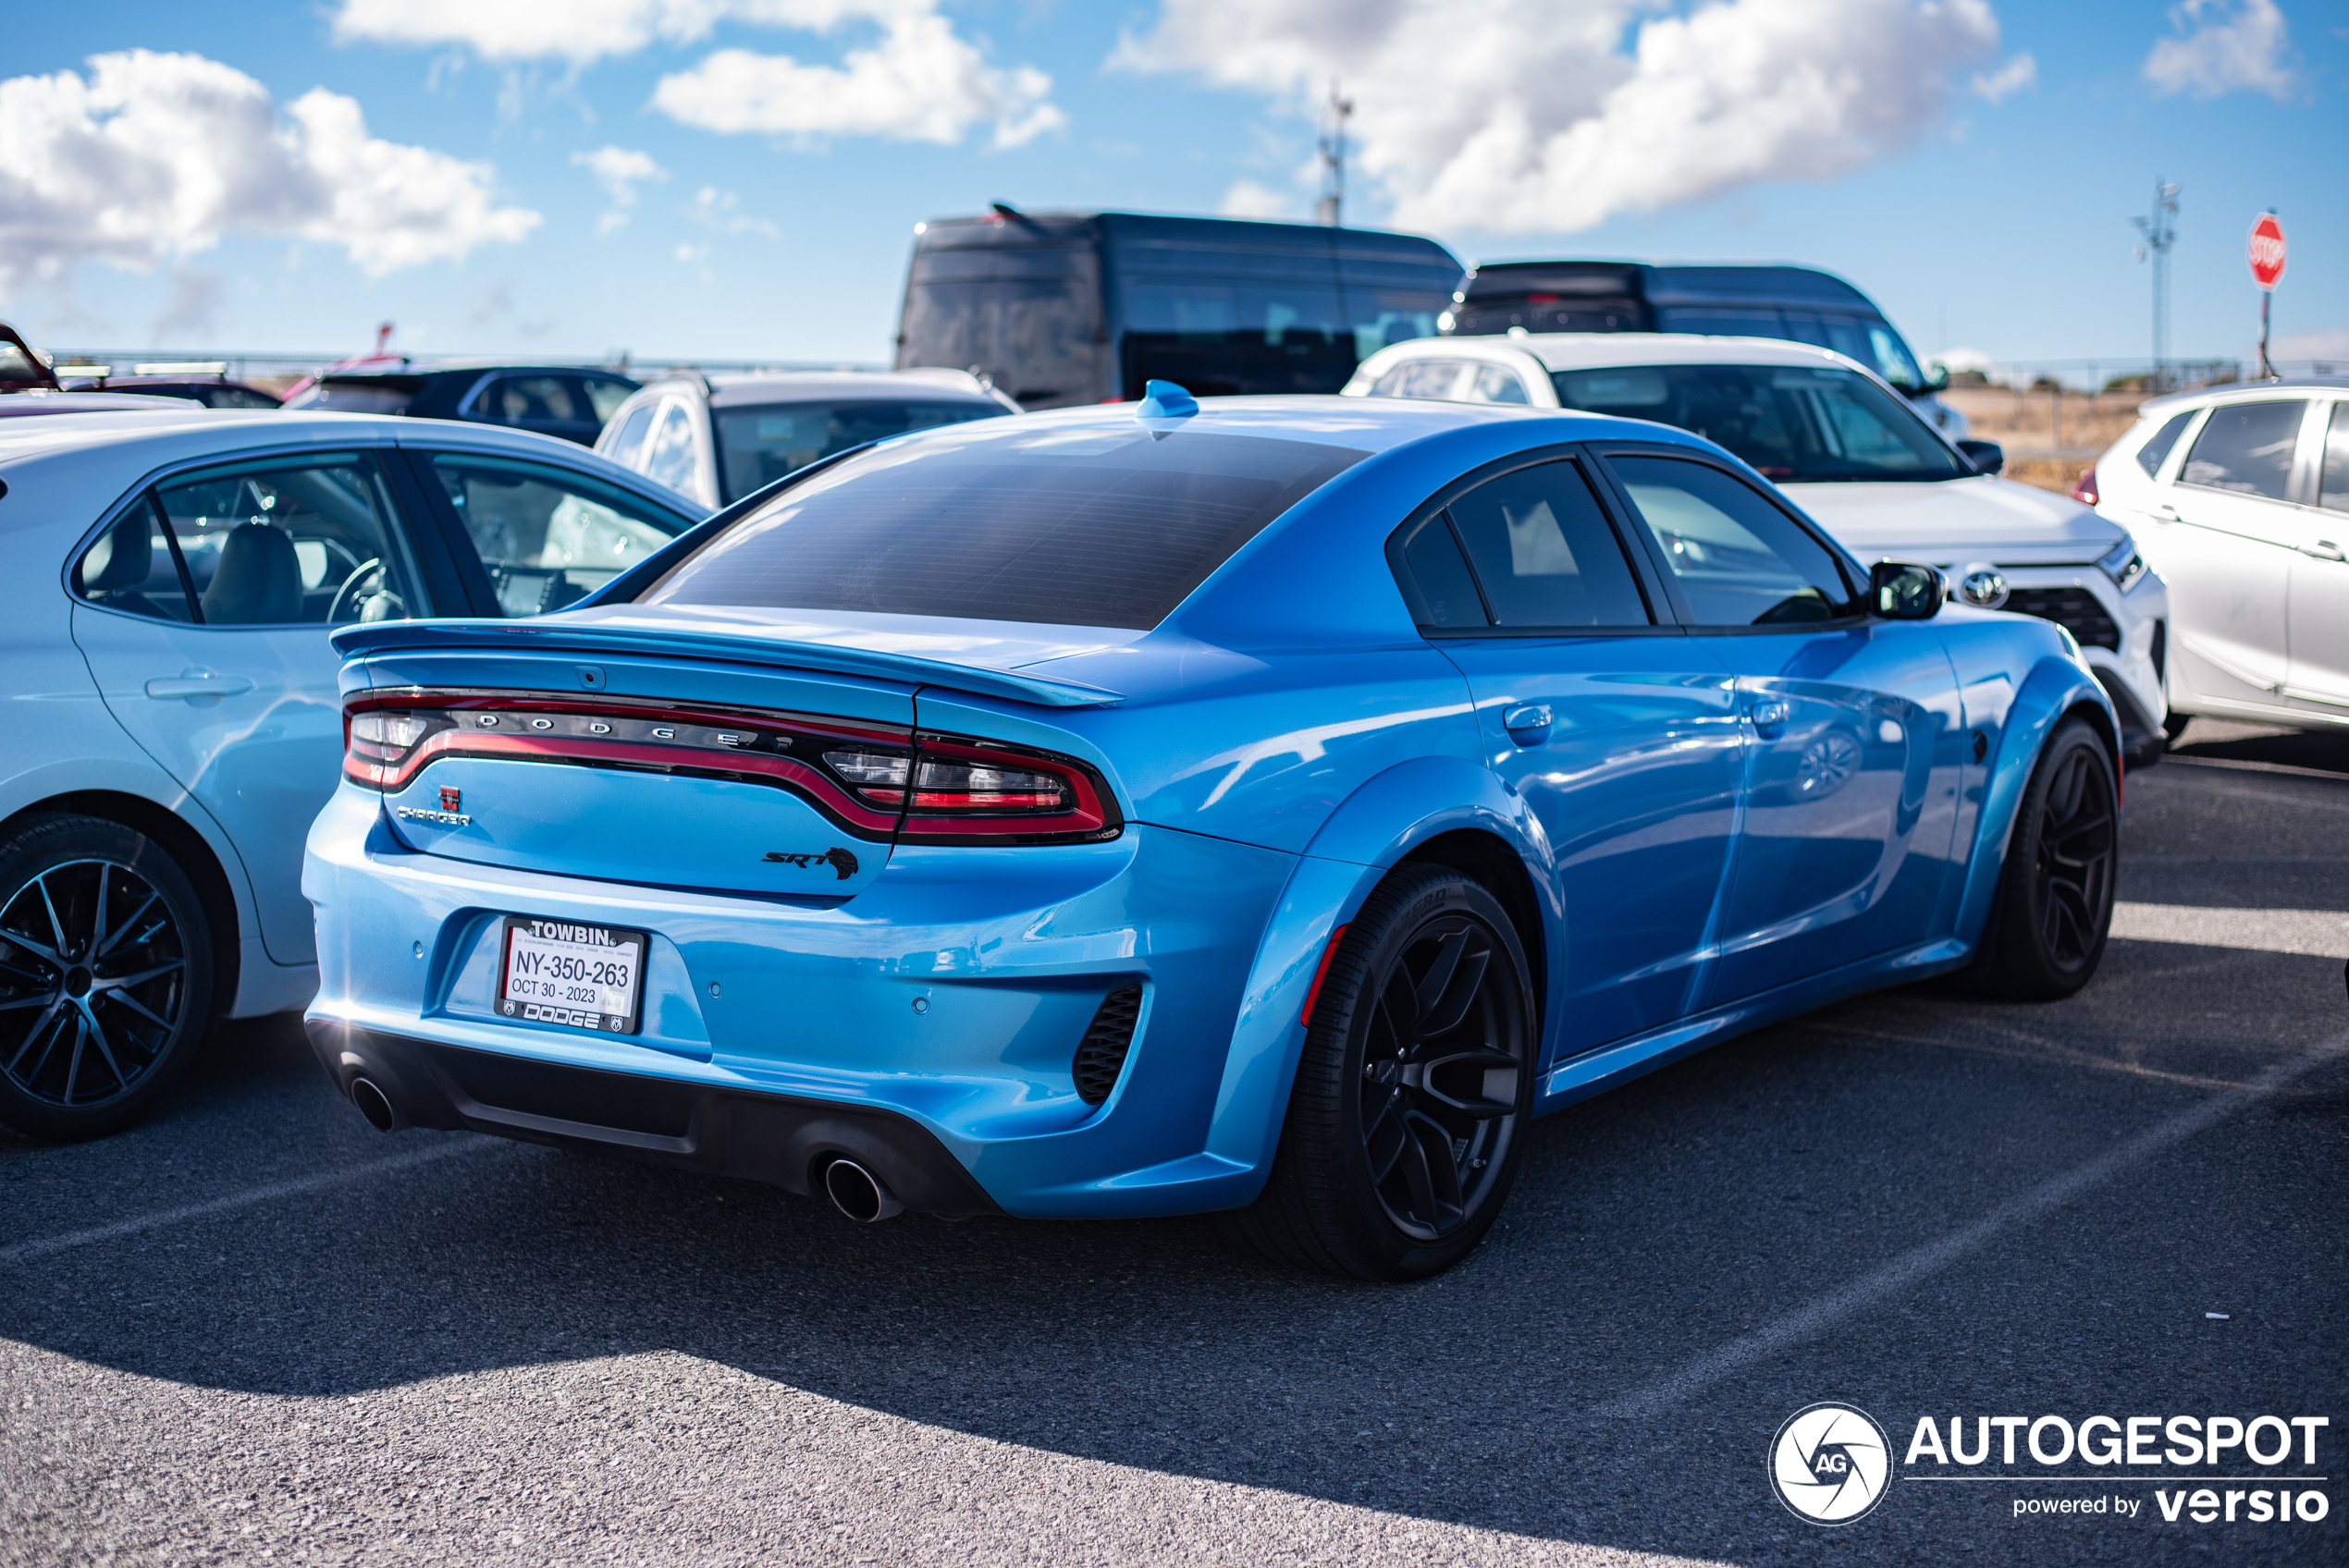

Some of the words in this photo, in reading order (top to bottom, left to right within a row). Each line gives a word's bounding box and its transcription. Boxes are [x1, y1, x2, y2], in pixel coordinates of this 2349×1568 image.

[2249, 234, 2286, 269] STOP
[479, 715, 740, 746] DODGE
[397, 805, 472, 827] CHARGER
[761, 851, 832, 869] SRT
[531, 921, 610, 946] TOWBIN
[516, 950, 629, 987] NY-350-263
[512, 978, 539, 996] OCT
[541, 983, 555, 998] 30
[566, 986, 596, 1004] 2023
[523, 1003, 600, 1030] DODGE
